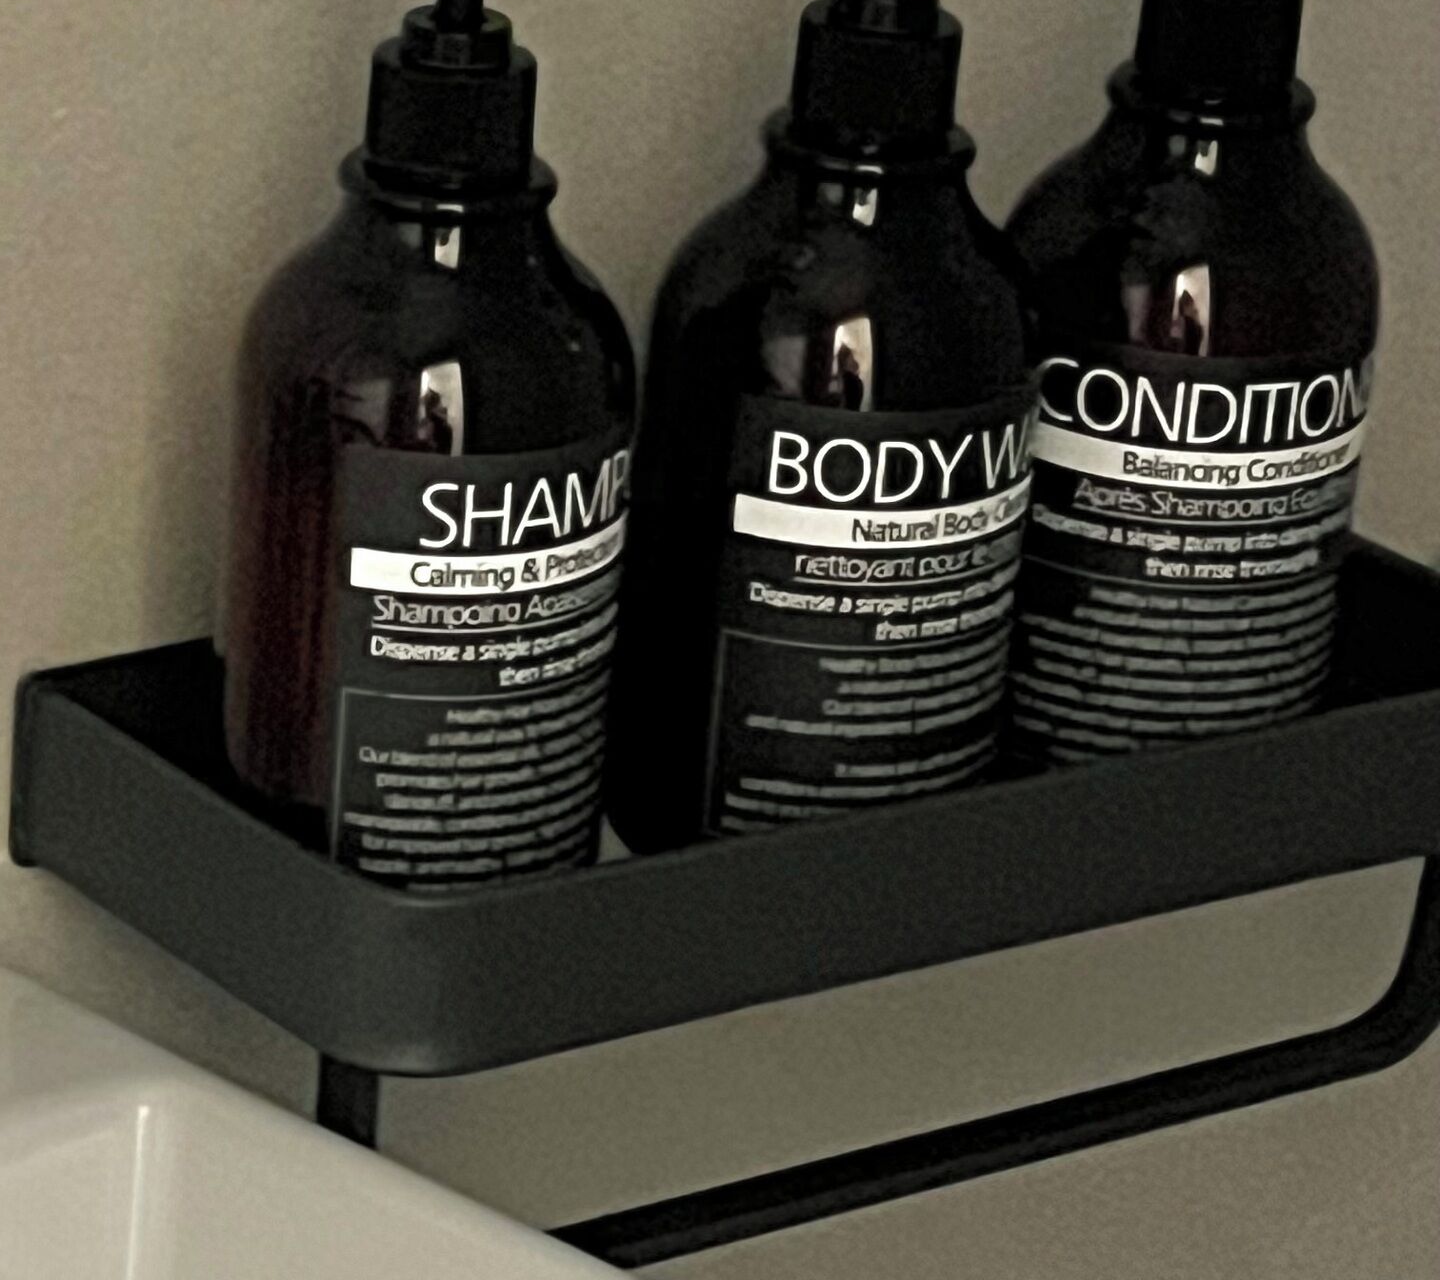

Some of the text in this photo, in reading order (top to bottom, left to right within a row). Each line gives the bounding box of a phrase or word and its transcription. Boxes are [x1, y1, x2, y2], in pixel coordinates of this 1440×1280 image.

[1037, 358, 1368, 444] CONDITION
[768, 414, 1030, 503] BODY W
[1123, 451, 1240, 486] Balancing
[419, 448, 631, 549] SHAMP
[851, 518, 939, 543] Natural
[410, 561, 515, 591] Calming
[521, 558, 540, 583] &
[373, 595, 521, 627] Shampooing
